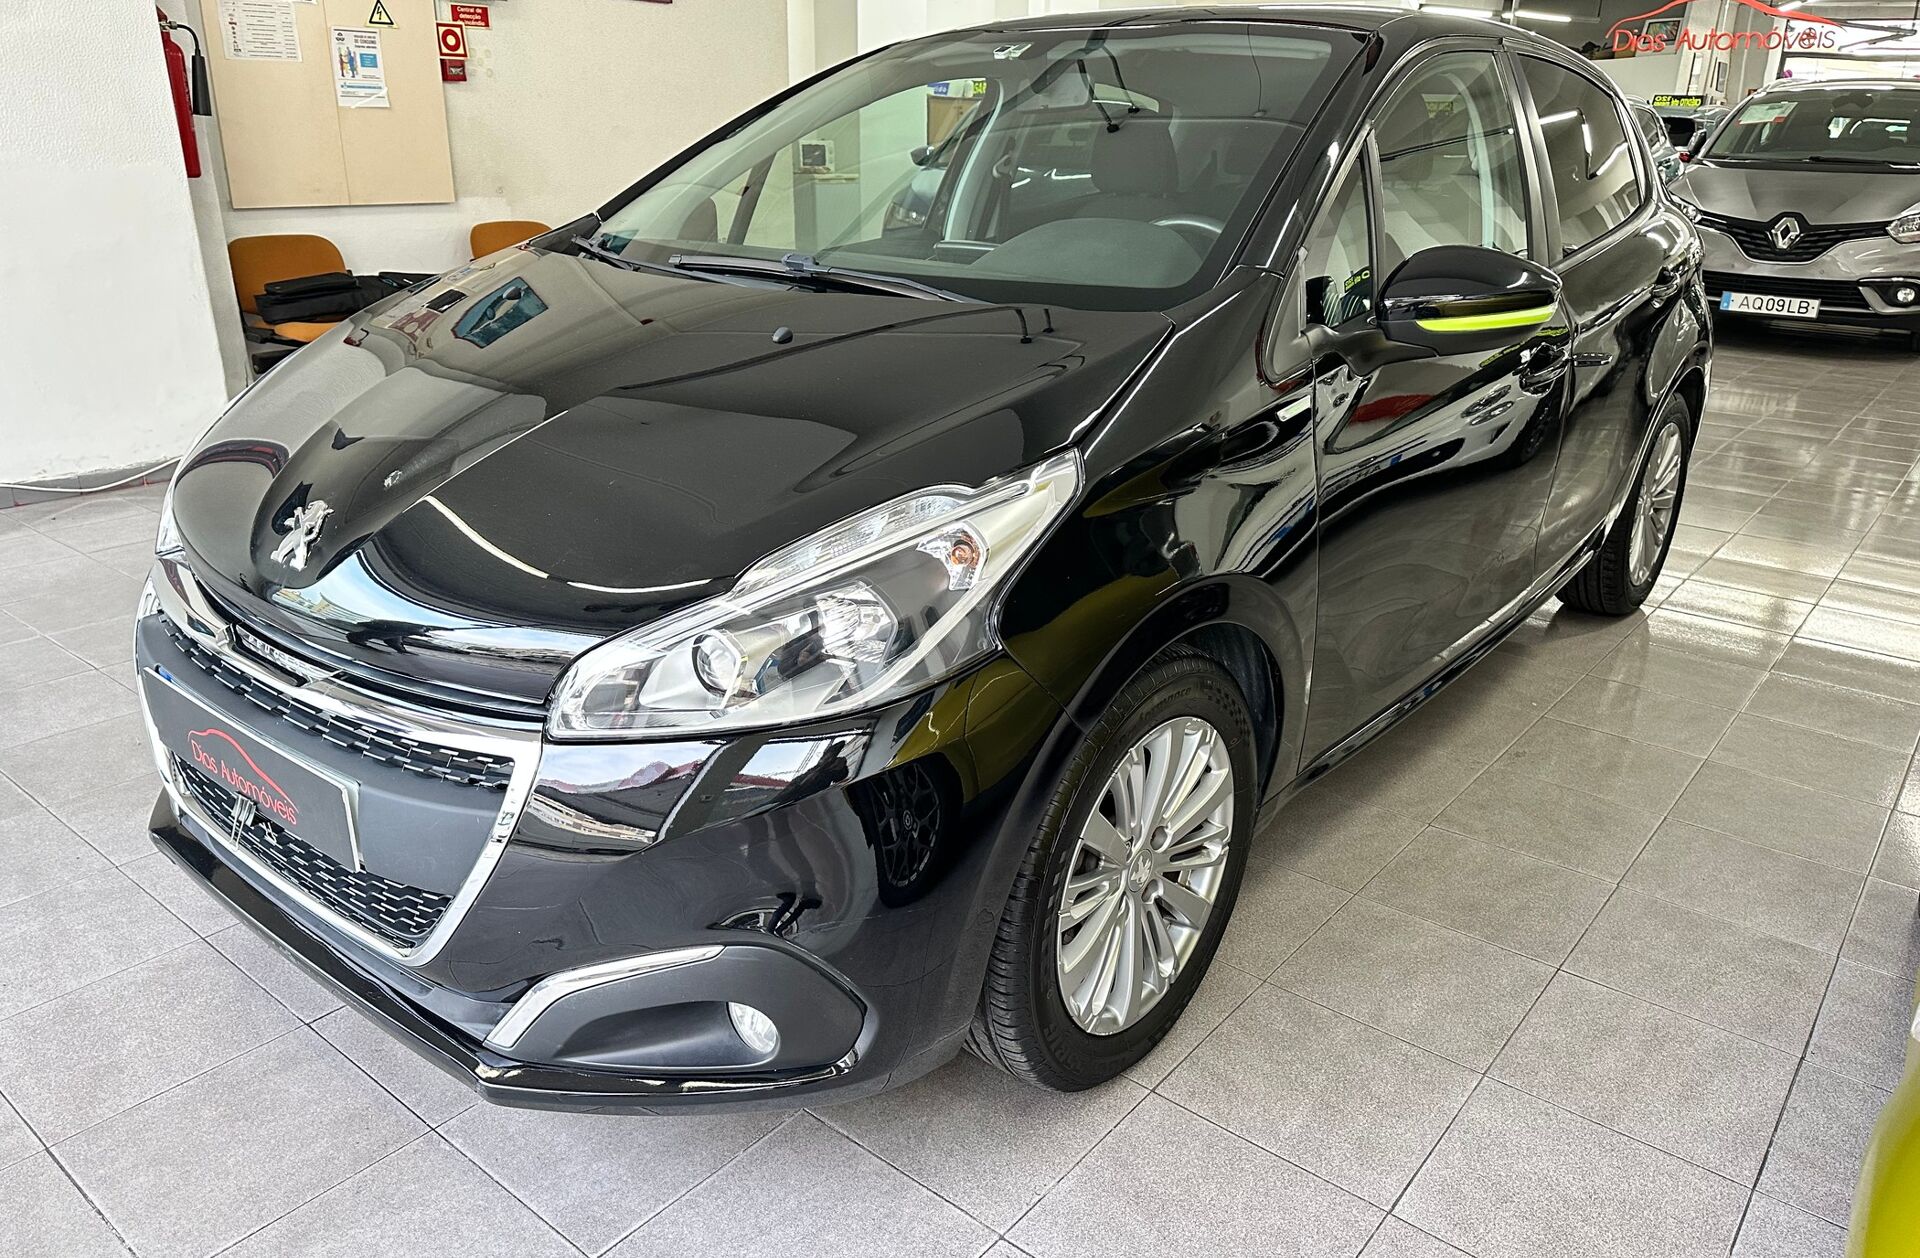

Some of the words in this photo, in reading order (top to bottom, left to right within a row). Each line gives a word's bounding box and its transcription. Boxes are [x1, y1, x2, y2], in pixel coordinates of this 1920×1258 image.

[1612, 29, 1667, 52] Dias
[1676, 25, 1836, 51] Automóveis
[1738, 295, 1811, 315] AQ09LB
[191, 739, 218, 774] Dias
[220, 759, 297, 825] Automóveis
